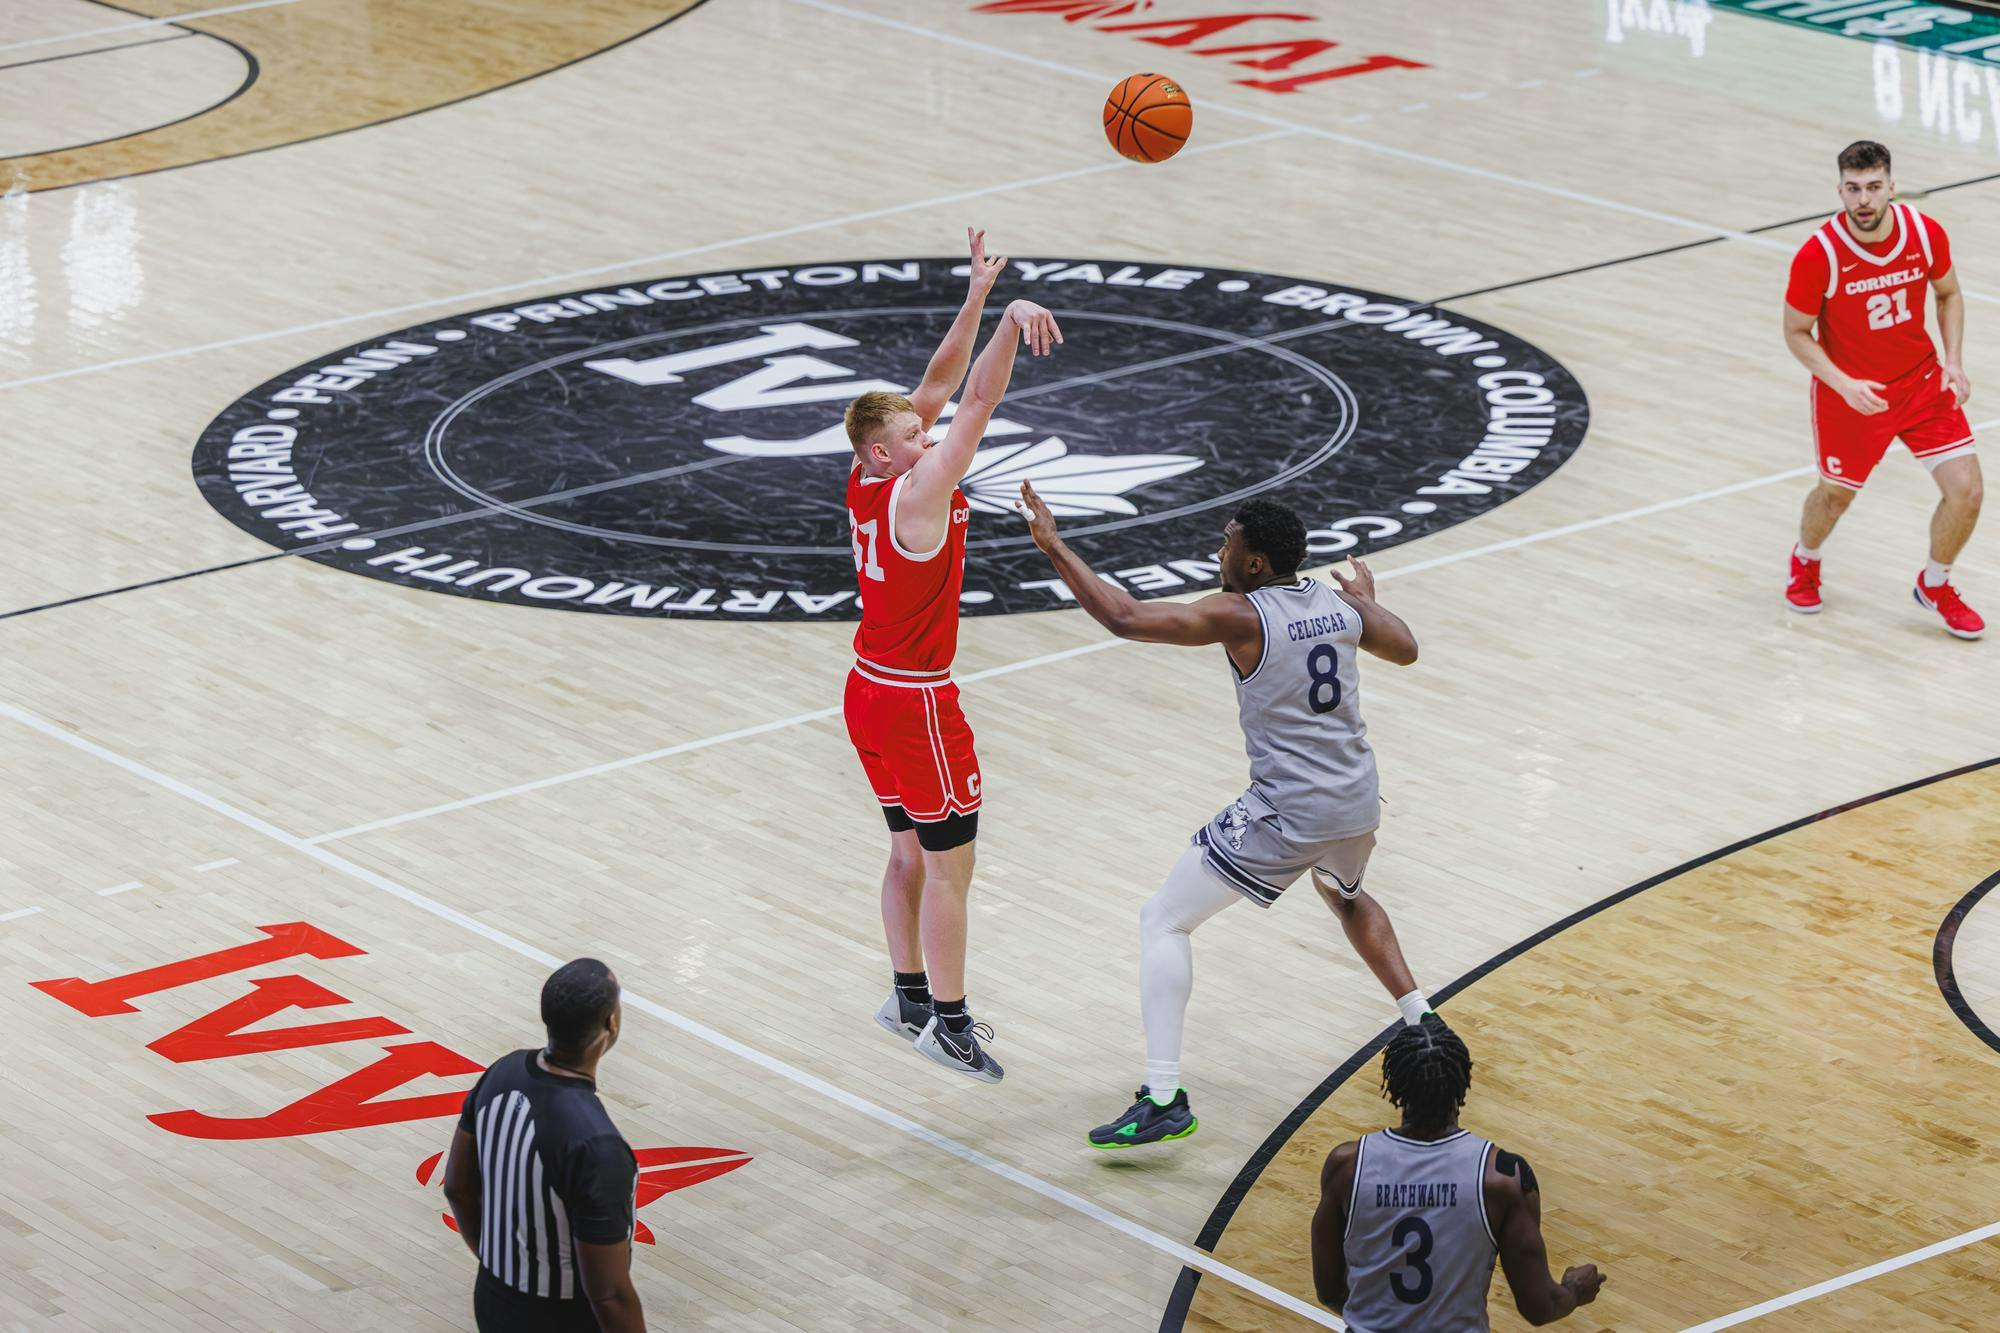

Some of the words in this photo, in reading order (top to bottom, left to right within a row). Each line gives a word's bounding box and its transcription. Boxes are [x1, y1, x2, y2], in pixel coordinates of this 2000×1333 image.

[470, 262, 920, 333] PRINCETON
[1013, 261, 1205, 290] YALE
[1844, 267, 1924, 296] CORNELL
[1263, 286, 1499, 356] BROWN
[1866, 287, 1912, 331] 21
[286, 339, 439, 405] PENN
[1415, 369, 1558, 495] COLUMBIA
[226, 422, 360, 540] HARVARD
[1826, 456, 1842, 475] C
[366, 546, 863, 613] ARTMOUTH
[1287, 612, 1347, 642] CELISCAR
[1307, 643, 1341, 714] 8
[966, 772, 981, 797] C
[1376, 1183, 1458, 1208] BRATHWAITE
[1389, 1216, 1434, 1304] 3
